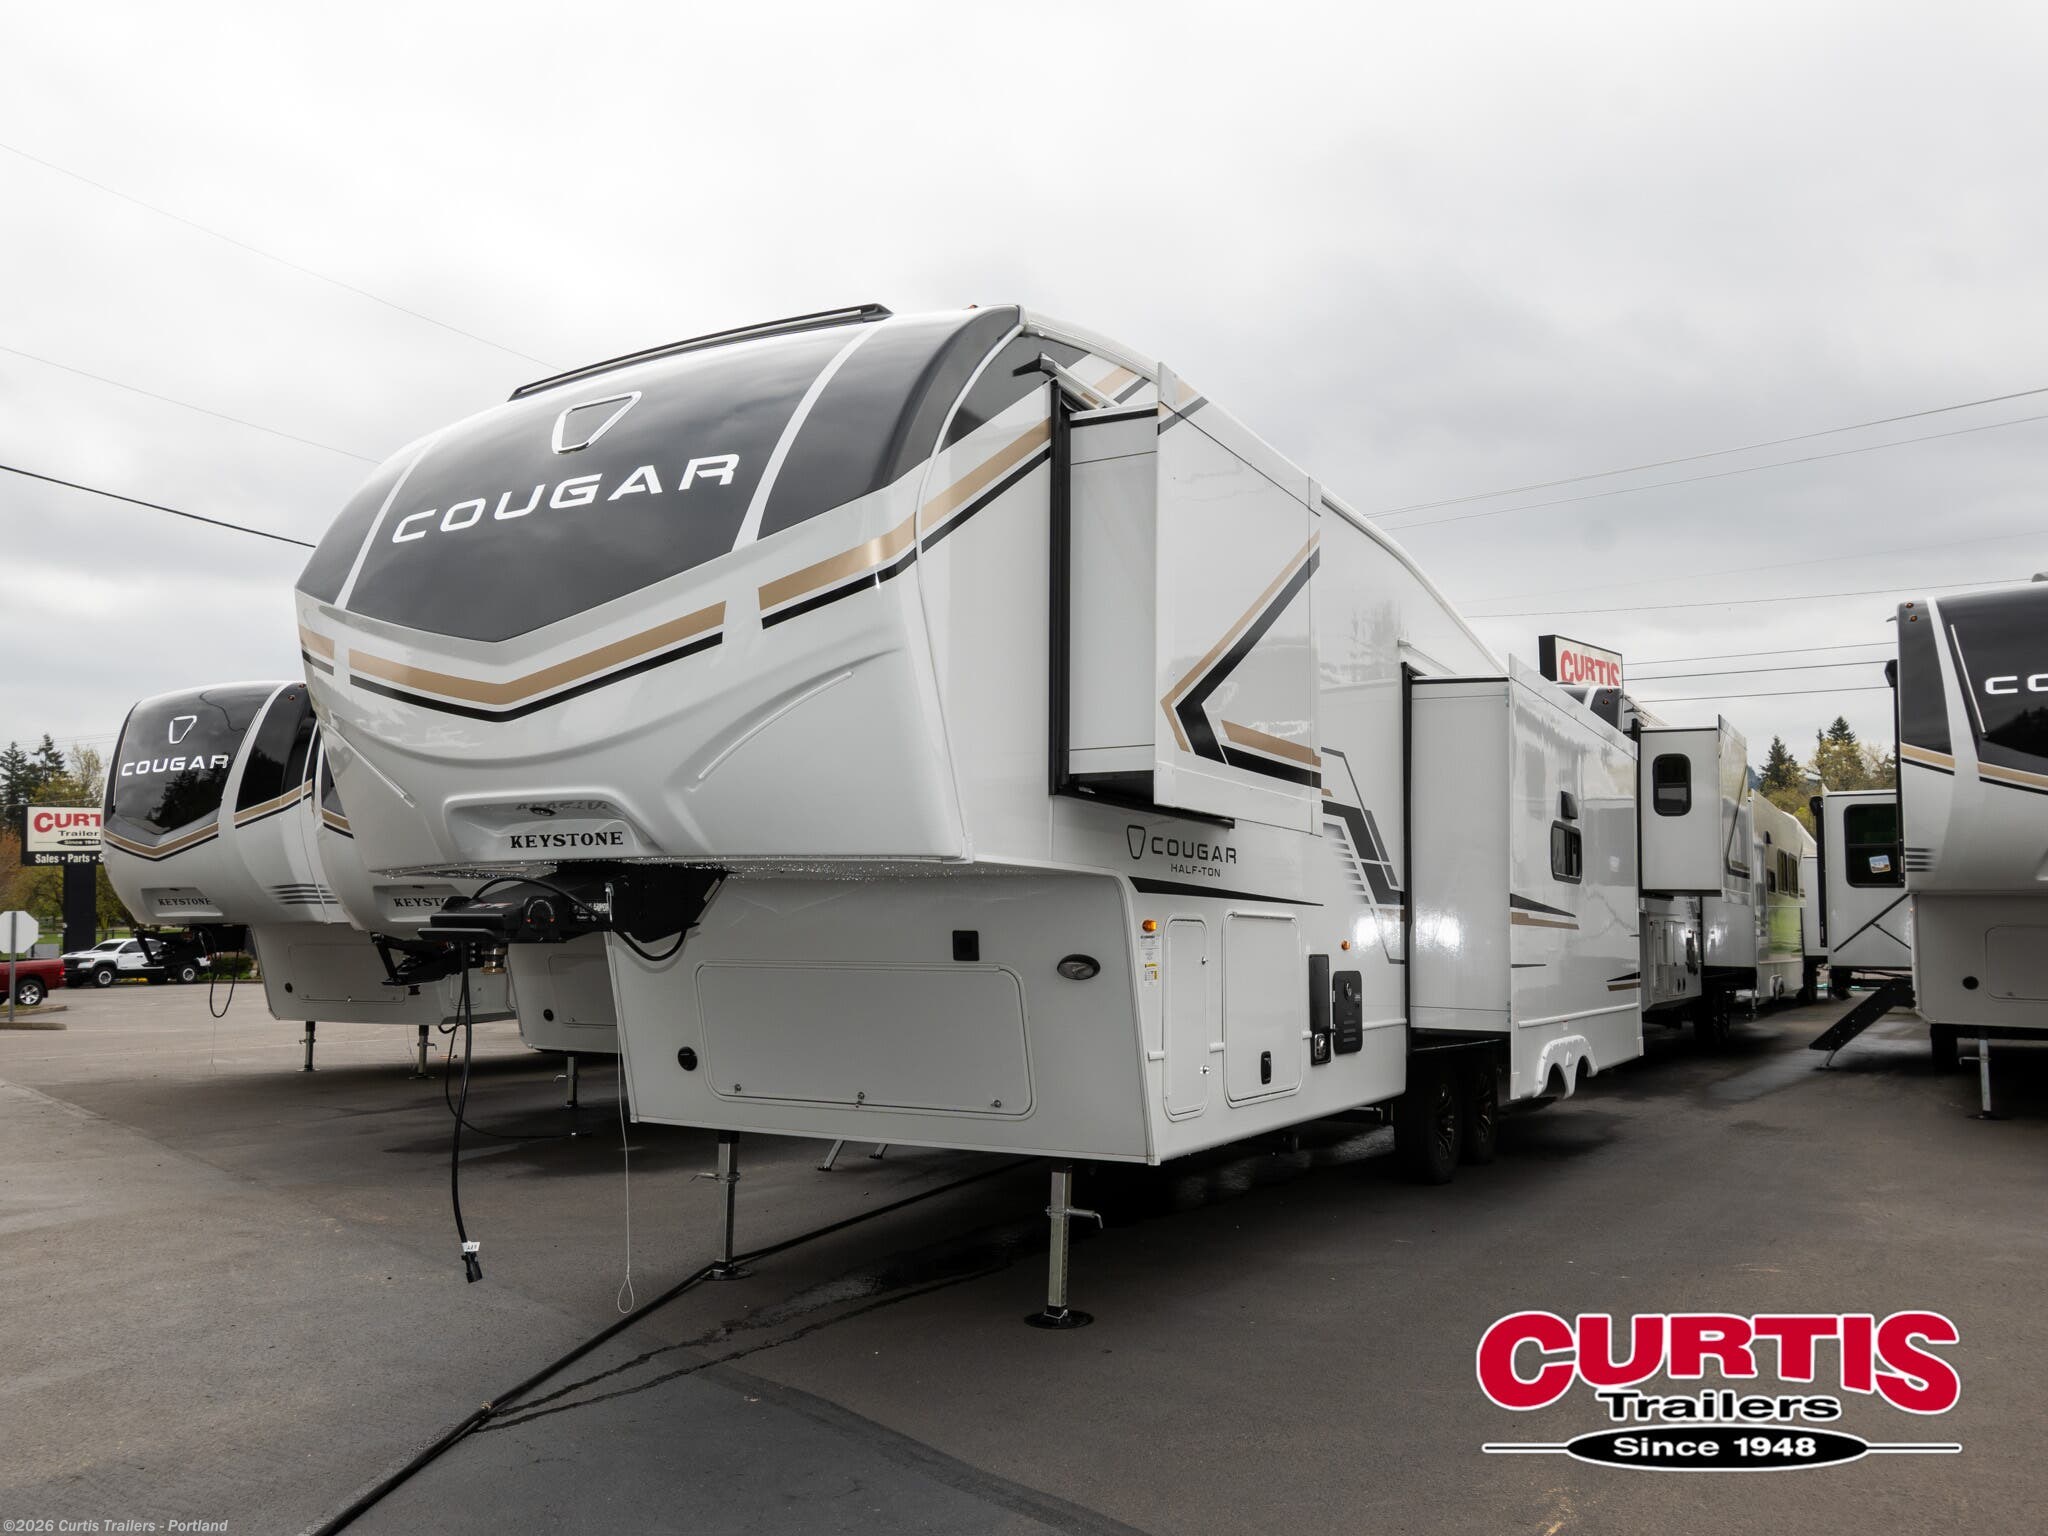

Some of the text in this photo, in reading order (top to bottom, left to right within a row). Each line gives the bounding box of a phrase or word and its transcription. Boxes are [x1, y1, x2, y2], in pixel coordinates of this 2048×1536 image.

[391, 453, 740, 544] COUGAR
[1560, 650, 1619, 686] CURTIS
[121, 754, 229, 776] COUGAR
[510, 831, 624, 849] KEYSTONE
[35, 853, 60, 864] Sales
[67, 853, 90, 864] Parts
[1151, 837, 1237, 865] COUGAR
[1170, 863, 1221, 878] HALF-TON
[158, 897, 212, 906] KEYSTONE
